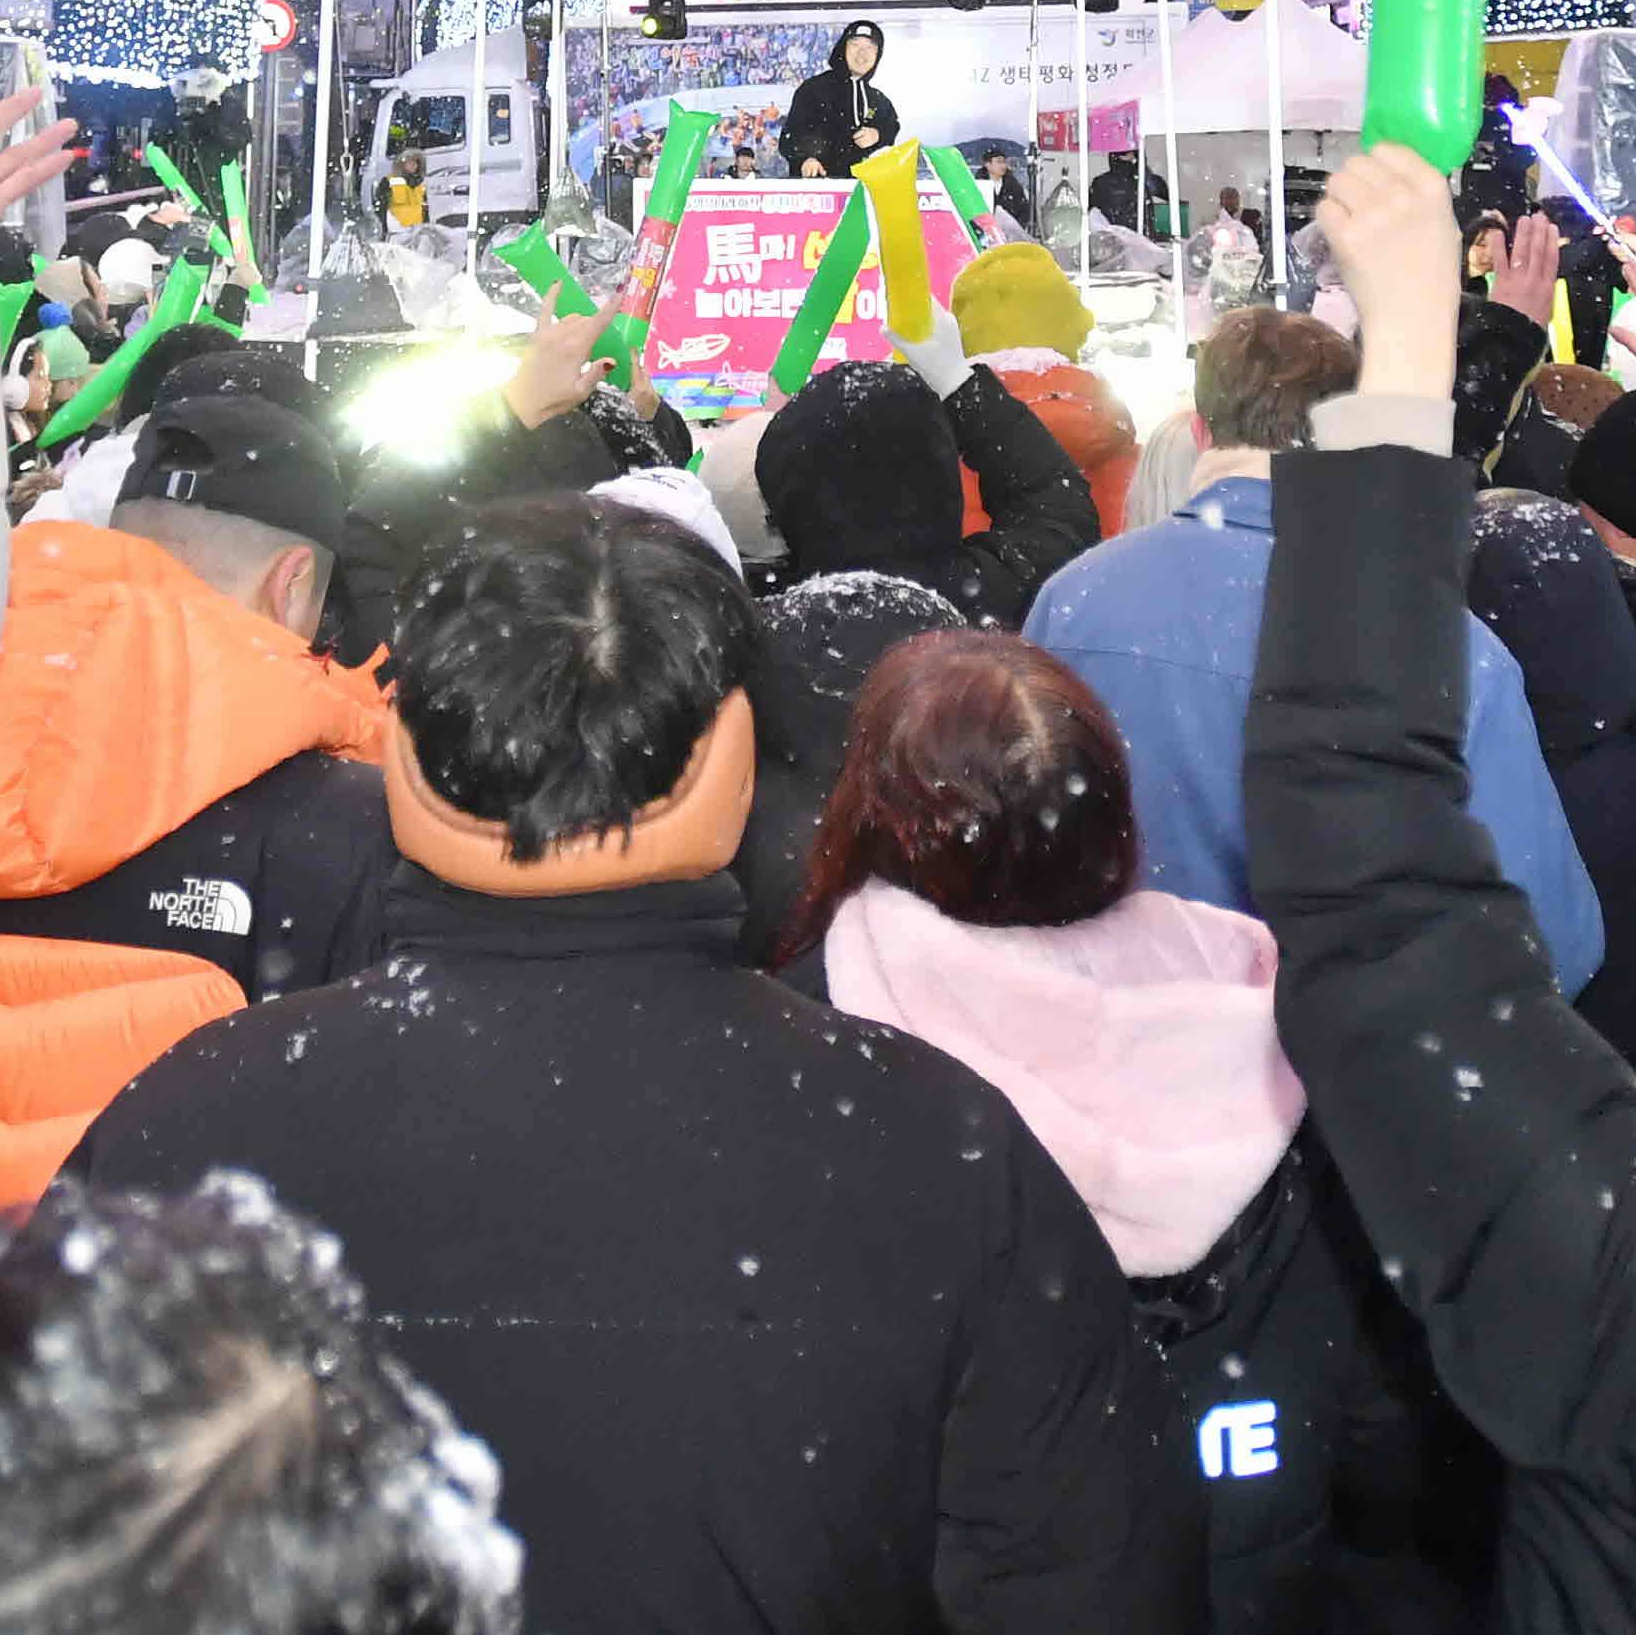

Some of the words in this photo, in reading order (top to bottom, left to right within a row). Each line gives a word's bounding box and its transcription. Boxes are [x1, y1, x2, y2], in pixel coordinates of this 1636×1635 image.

[182, 878, 222, 897] THE
[149, 891, 217, 913] NORTH
[167, 910, 214, 930] FACE
